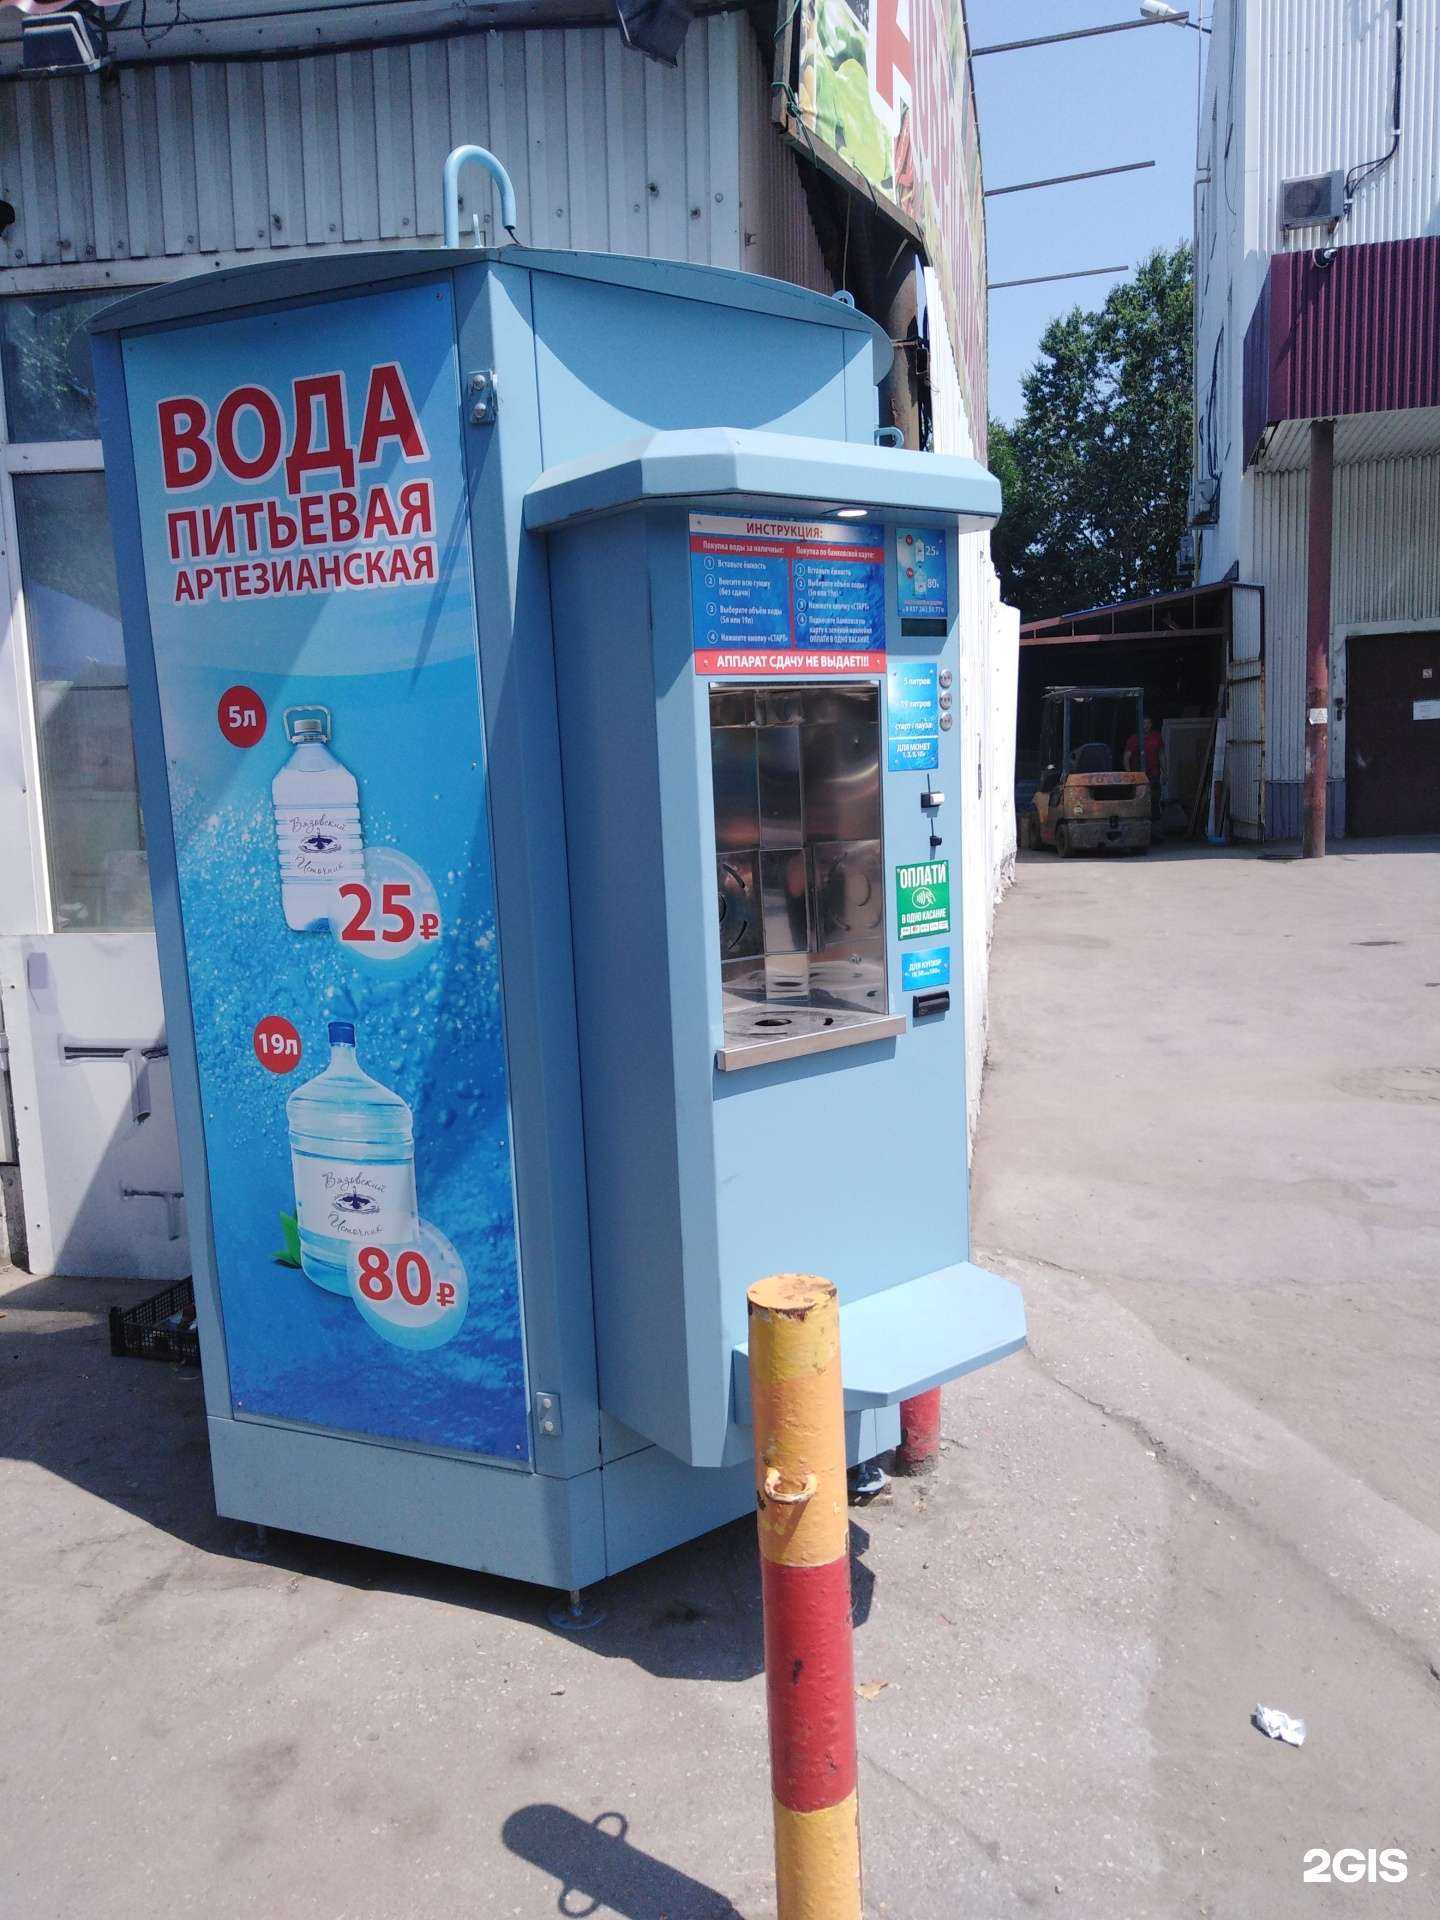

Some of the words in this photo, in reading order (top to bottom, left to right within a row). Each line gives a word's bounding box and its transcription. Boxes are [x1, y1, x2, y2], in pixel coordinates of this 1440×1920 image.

[158, 365, 425, 495] ВОДА
[168, 482, 432, 559] ПИТЬЕВАЯ
[747, 522, 823, 541] ИНСТРУКЦИЯ:
[175, 545, 434, 602] АРТЕЗИАНСКАЯ
[717, 655, 767, 668] АППАРАТ
[769, 655, 803, 670] СДАЧУ
[805, 655, 820, 667] НЕ
[228, 705, 257, 728] 5л
[899, 864, 947, 888] ОПЛАТИ
[258, 1032, 298, 1056] 19л
